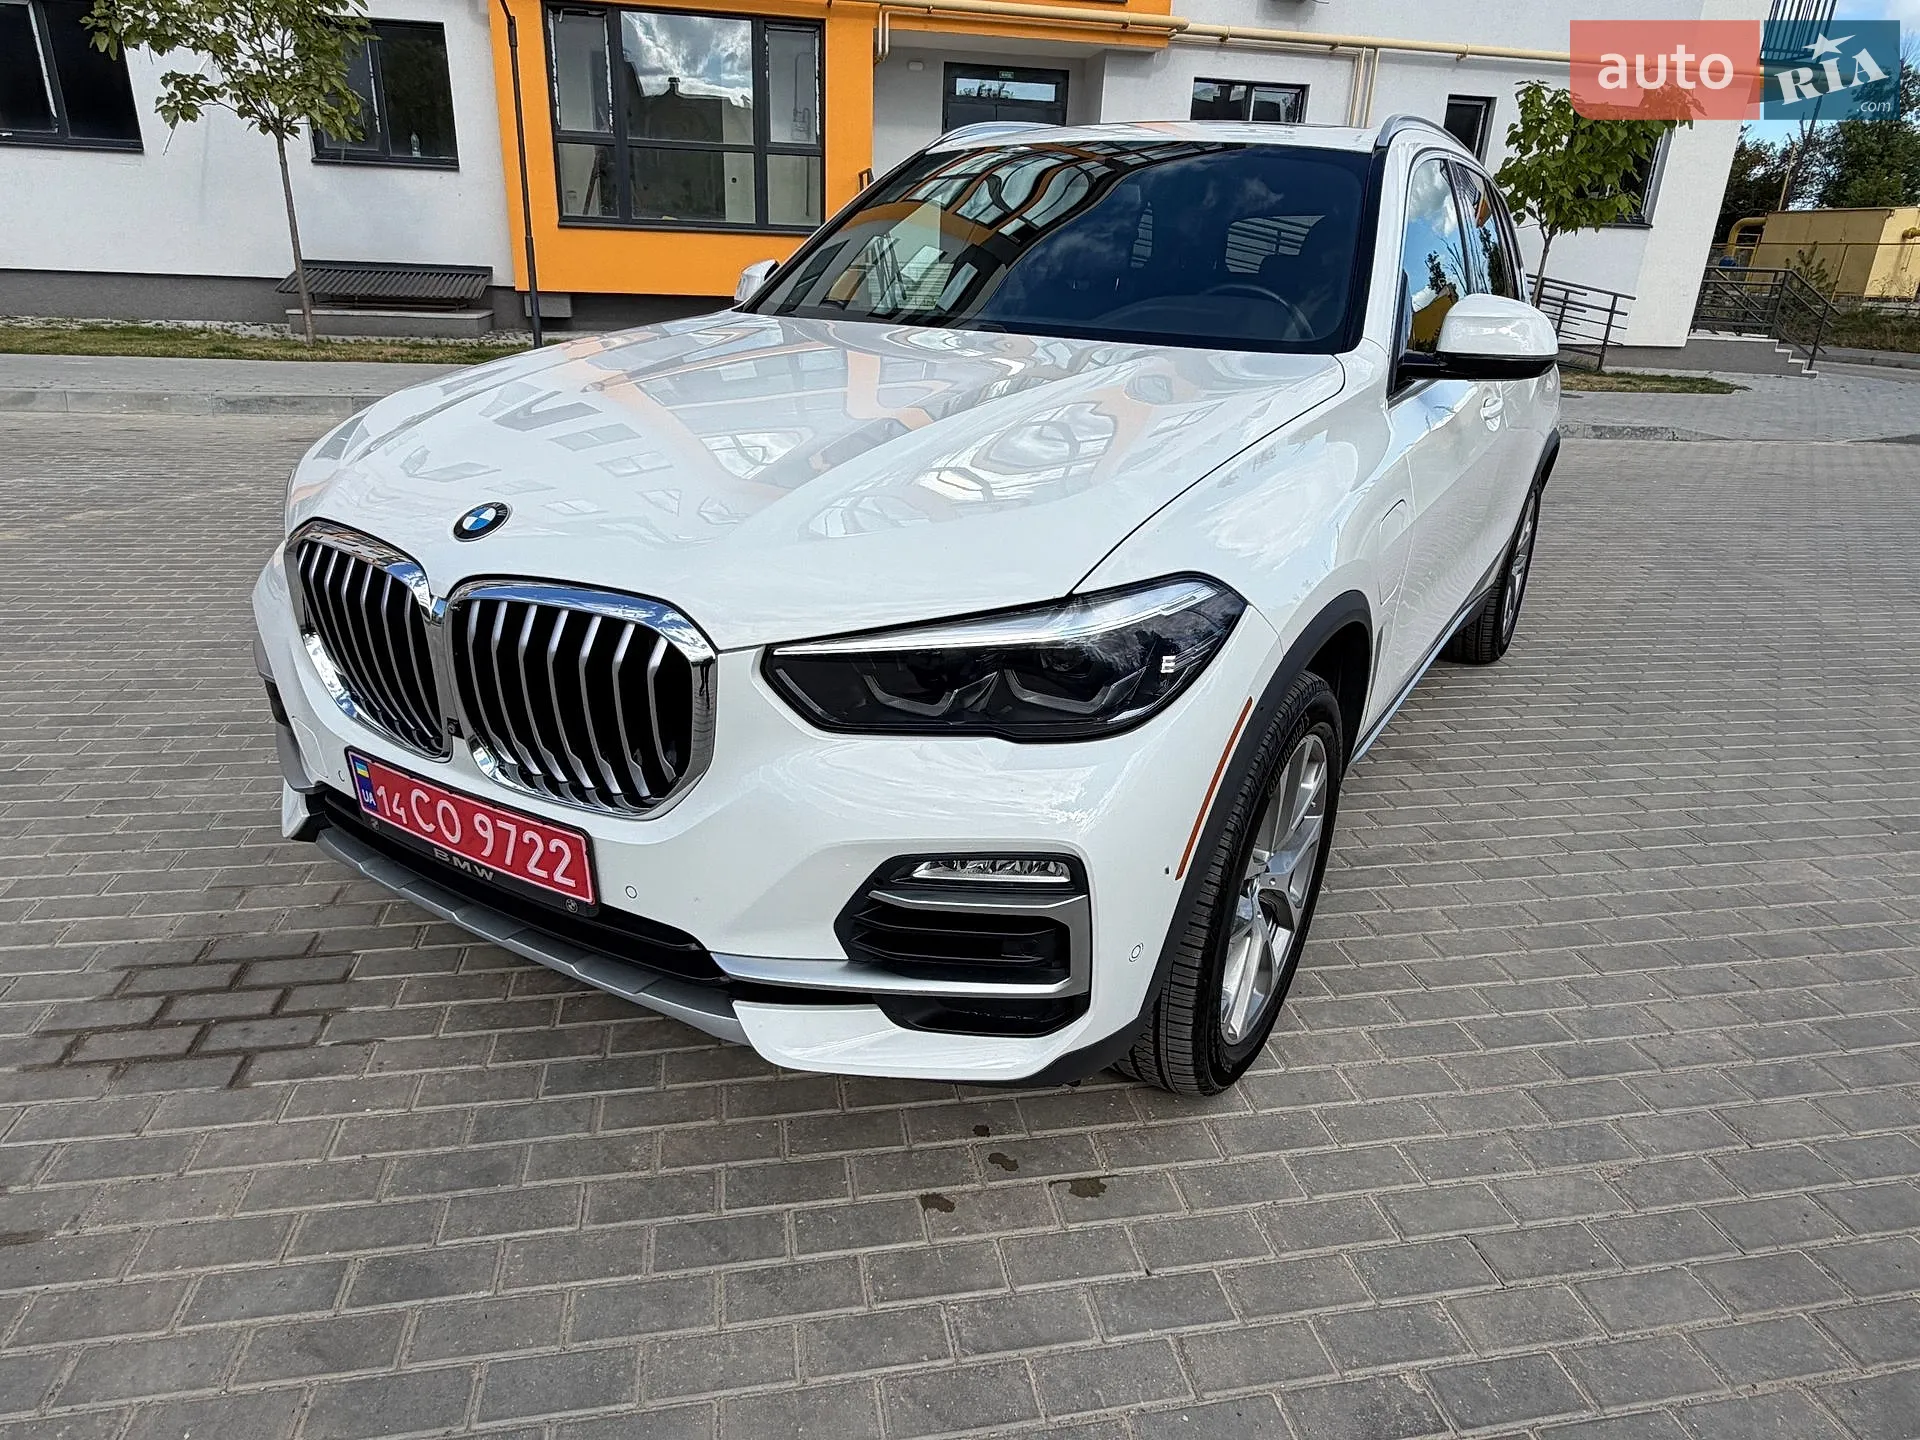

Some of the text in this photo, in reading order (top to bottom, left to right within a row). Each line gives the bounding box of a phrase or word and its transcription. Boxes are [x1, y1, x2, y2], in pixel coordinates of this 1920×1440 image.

[361, 788, 377, 807] UA
[376, 785, 577, 888] 14CO 9722
[433, 847, 494, 881] BMW
